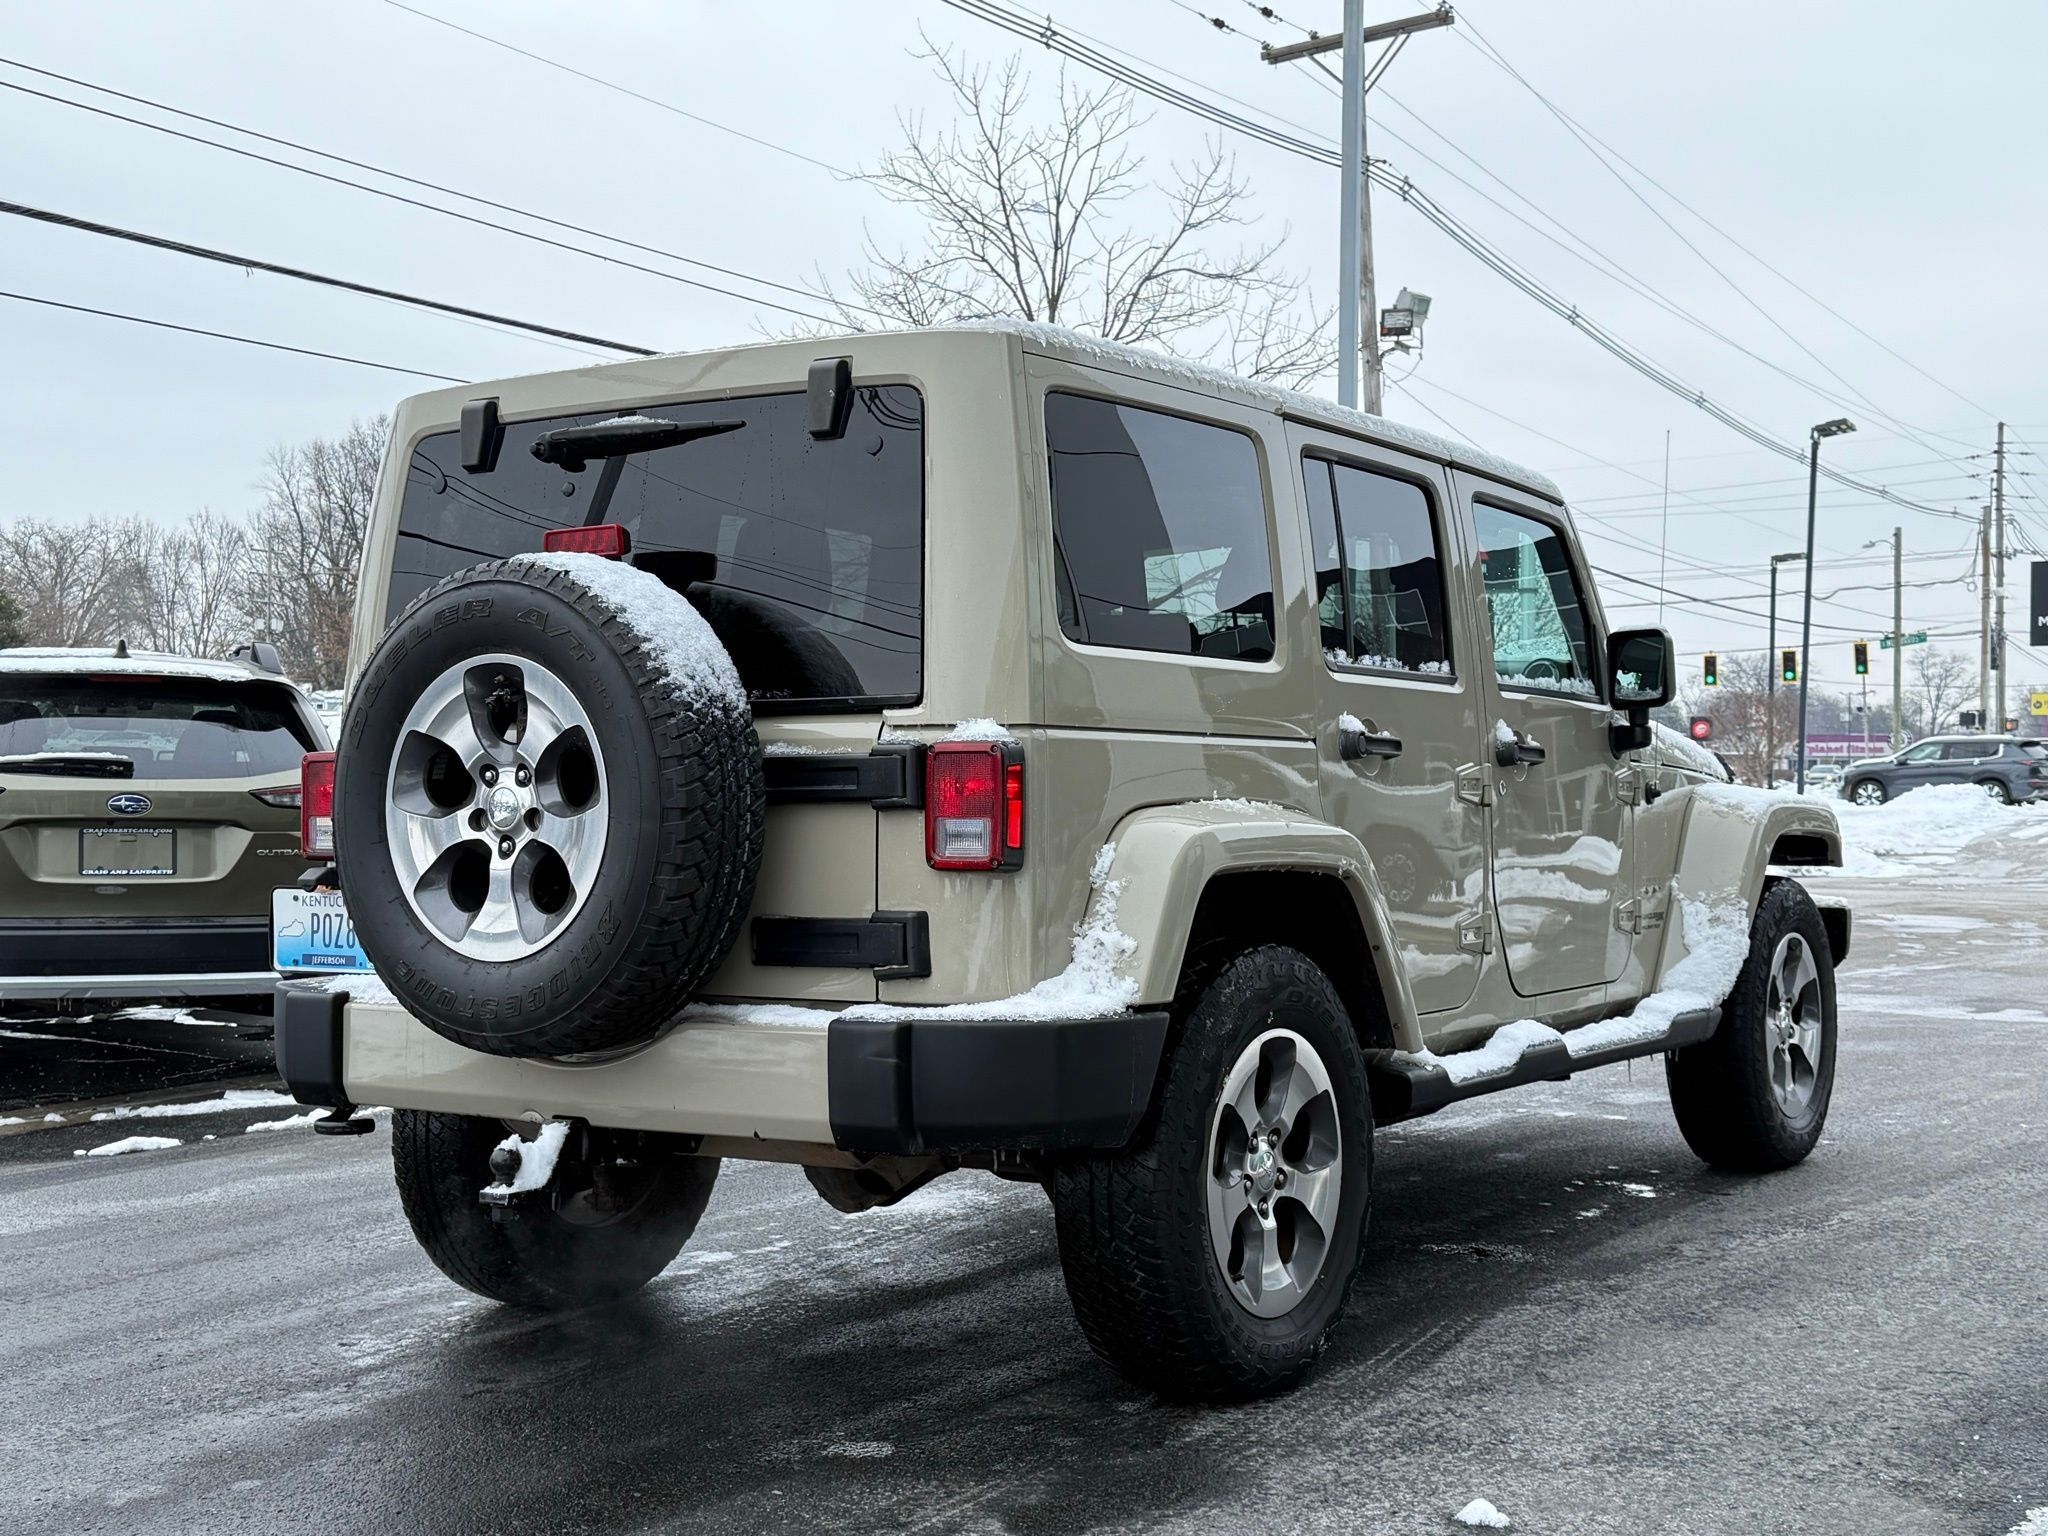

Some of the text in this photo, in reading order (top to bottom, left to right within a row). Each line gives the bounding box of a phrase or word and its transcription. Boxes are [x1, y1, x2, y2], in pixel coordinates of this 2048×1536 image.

[516, 606, 597, 663] A/T
[301, 895, 346, 908] KENTUC
[311, 956, 346, 966] JEFFERSON
[393, 900, 622, 1022] BRIDGESTONE
